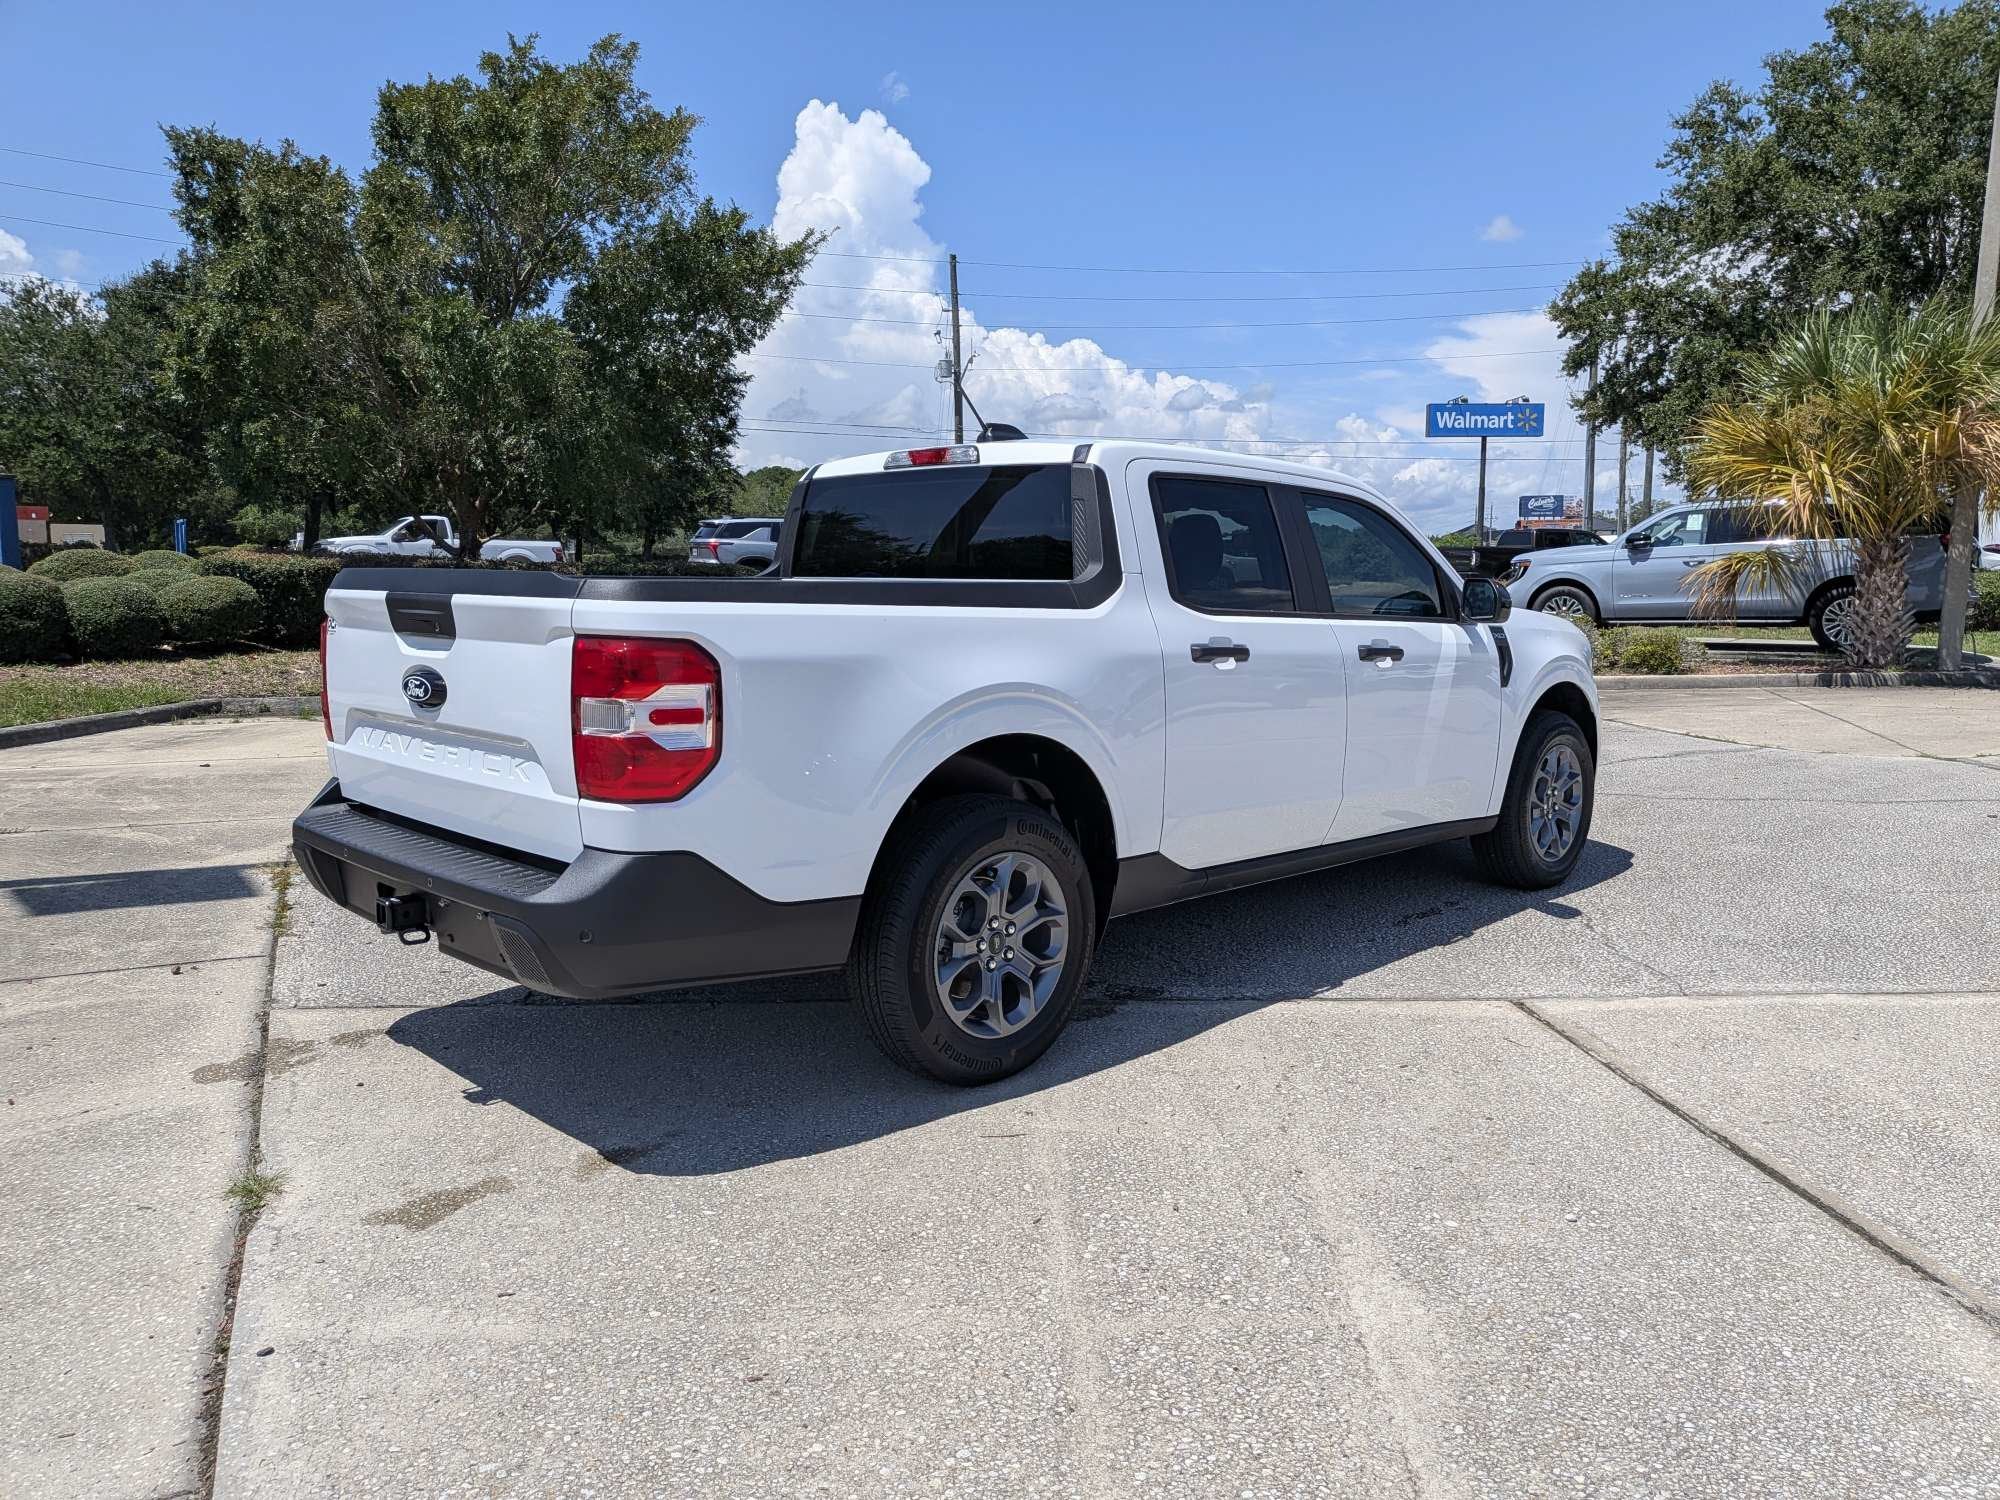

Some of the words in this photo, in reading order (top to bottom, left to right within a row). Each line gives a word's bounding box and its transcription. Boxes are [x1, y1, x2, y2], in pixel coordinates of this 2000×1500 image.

[1436, 411, 1514, 429] Walmart
[407, 679, 425, 697] Ford
[357, 726, 532, 783] MAVERICK
[1016, 818, 1073, 858] Continental
[938, 1040, 1003, 1073] Continental
